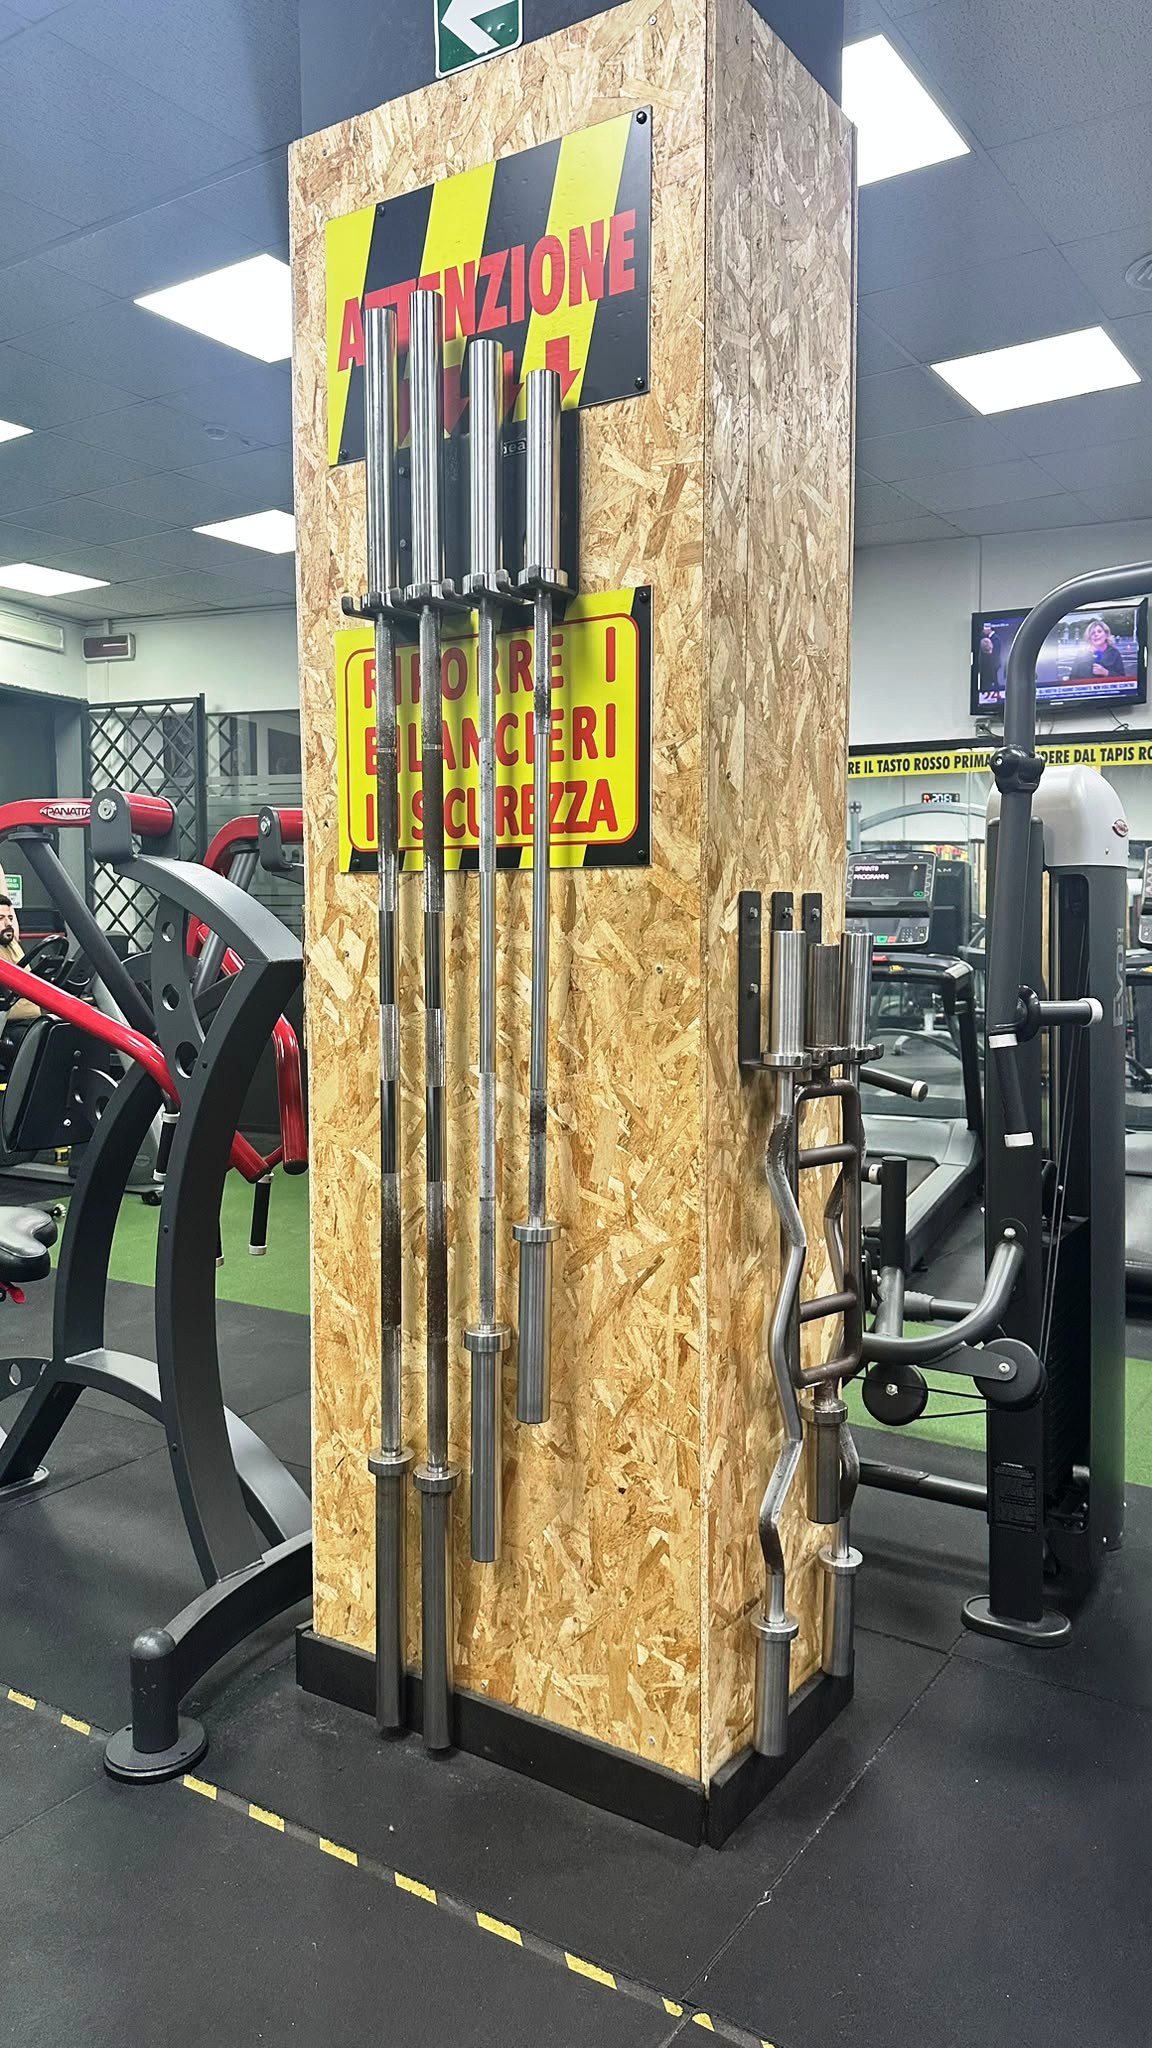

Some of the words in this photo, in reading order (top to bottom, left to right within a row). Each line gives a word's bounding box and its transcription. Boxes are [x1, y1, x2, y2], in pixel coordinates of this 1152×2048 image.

[605, 626, 616, 683] I
[864, 760, 874, 774] IL
[877, 758, 911, 773] TASTO
[914, 755, 951, 771] ROSSO
[954, 753, 991, 769] PRIMA
[1074, 749, 1096, 763] DAL
[1100, 747, 1135, 762] TAPIS
[411, 778, 618, 841] SCUREZZA
